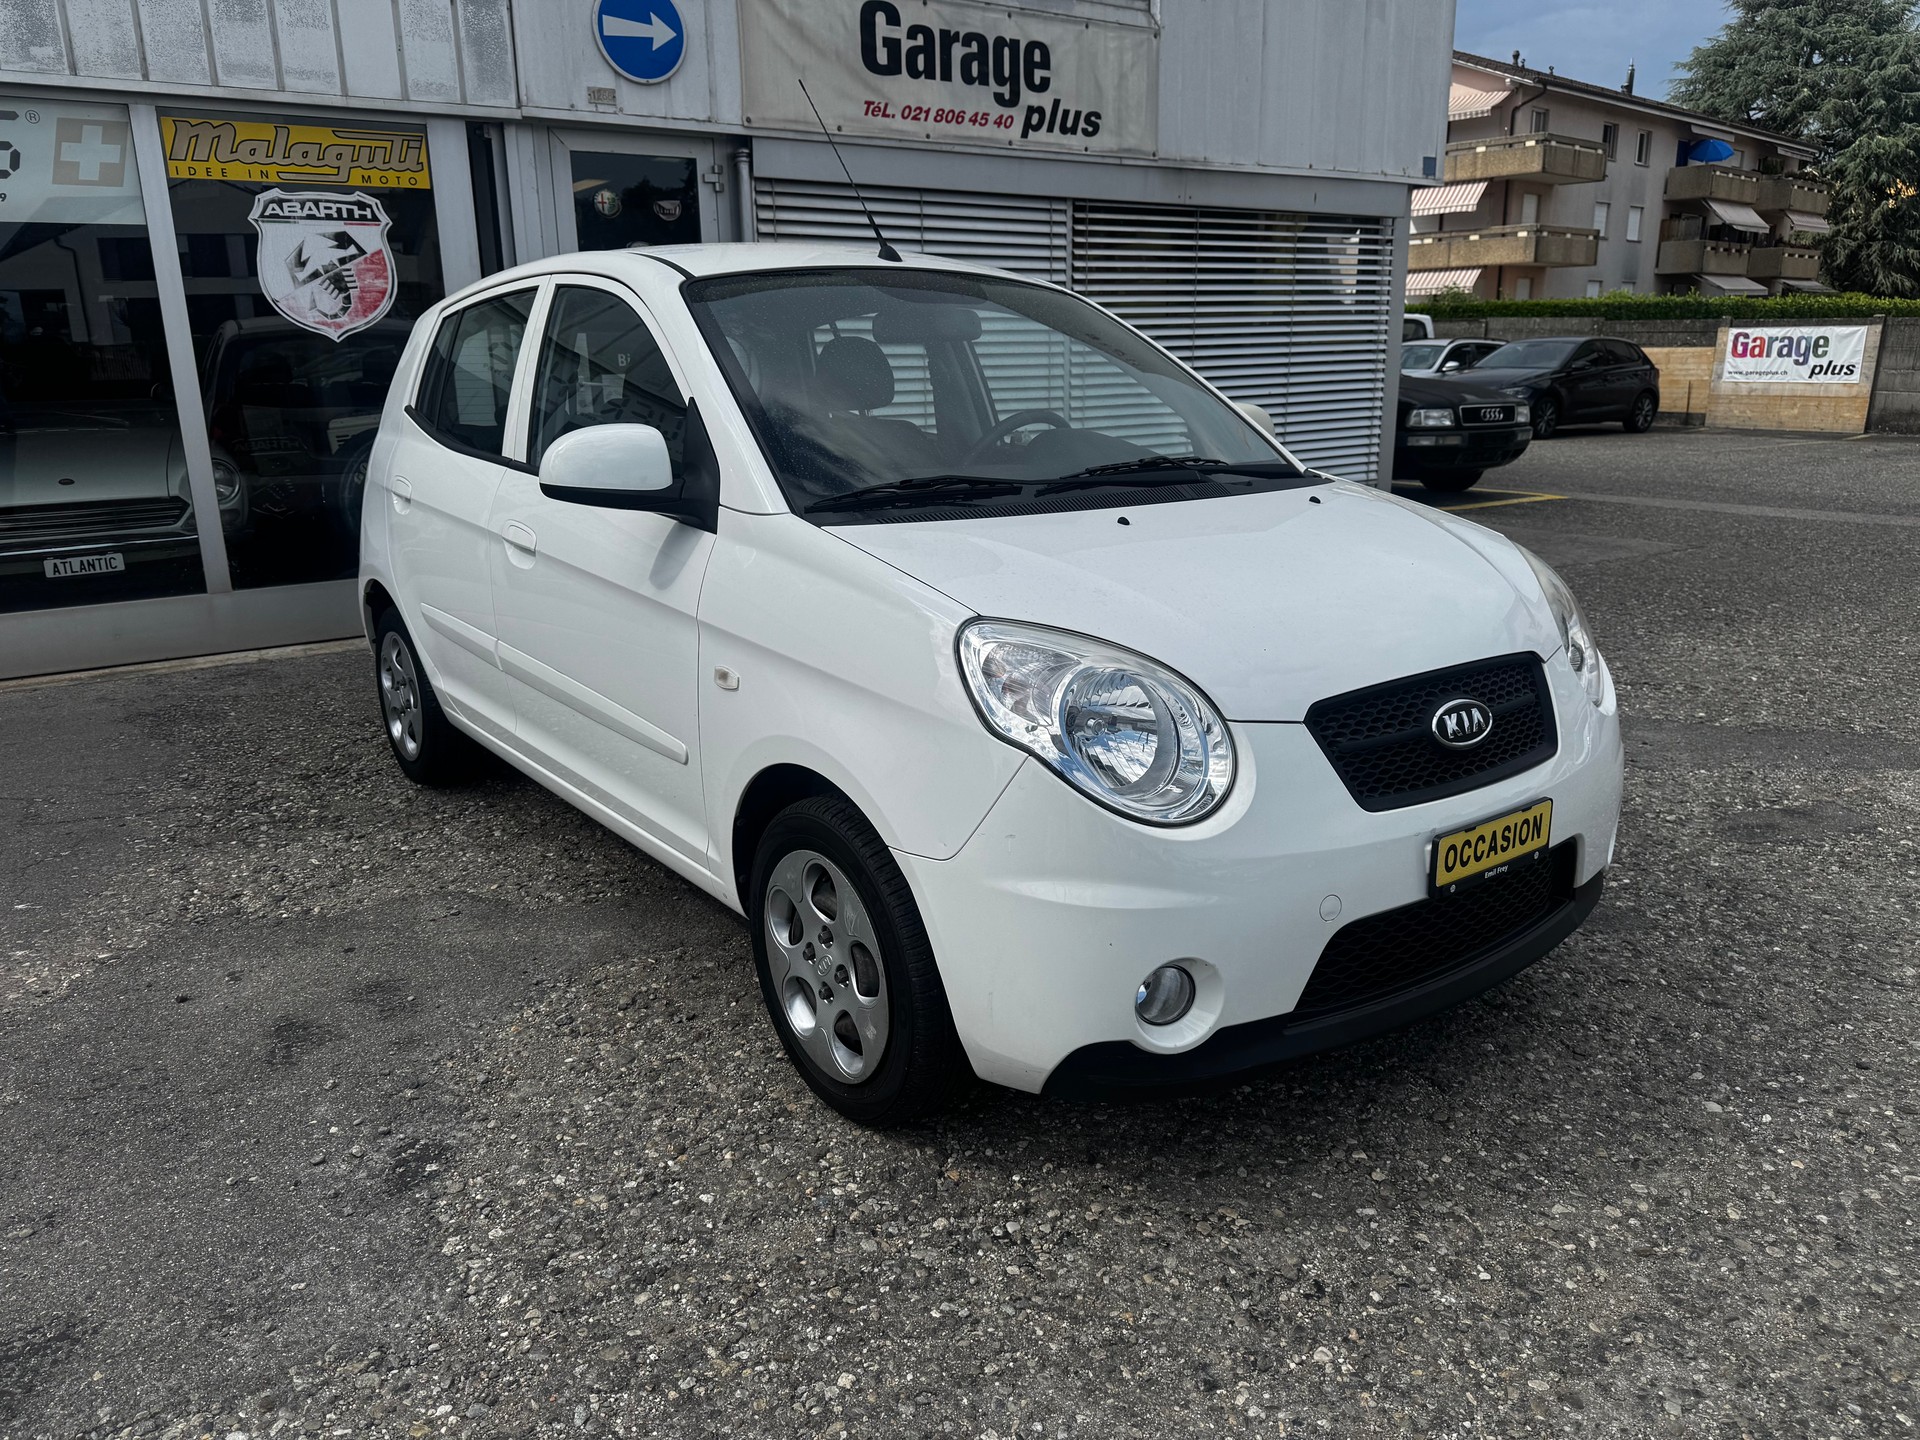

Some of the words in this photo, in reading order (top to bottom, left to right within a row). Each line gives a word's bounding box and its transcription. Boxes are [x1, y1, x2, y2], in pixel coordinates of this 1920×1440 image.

[860, 0, 1051, 108] Garage
[901, 105, 930, 122] 021
[933, 108, 965, 125] 806
[968, 112, 990, 127] 45
[993, 114, 1014, 129] 40
[1020, 98, 1102, 139] plus
[168, 119, 424, 183] Malaguti
[175, 165, 228, 178] IDEE
[248, 169, 270, 179] IN
[361, 174, 418, 186] MOTO
[264, 201, 373, 219] ABARTH
[1731, 331, 1830, 366] Garage
[1808, 360, 1856, 379] plus
[53, 557, 118, 575] ATLANTIC
[1442, 707, 1487, 739] KIA
[1444, 813, 1543, 873] OCCASION
[1484, 867, 1497, 879] Emil
[1497, 864, 1509, 875] Frey
